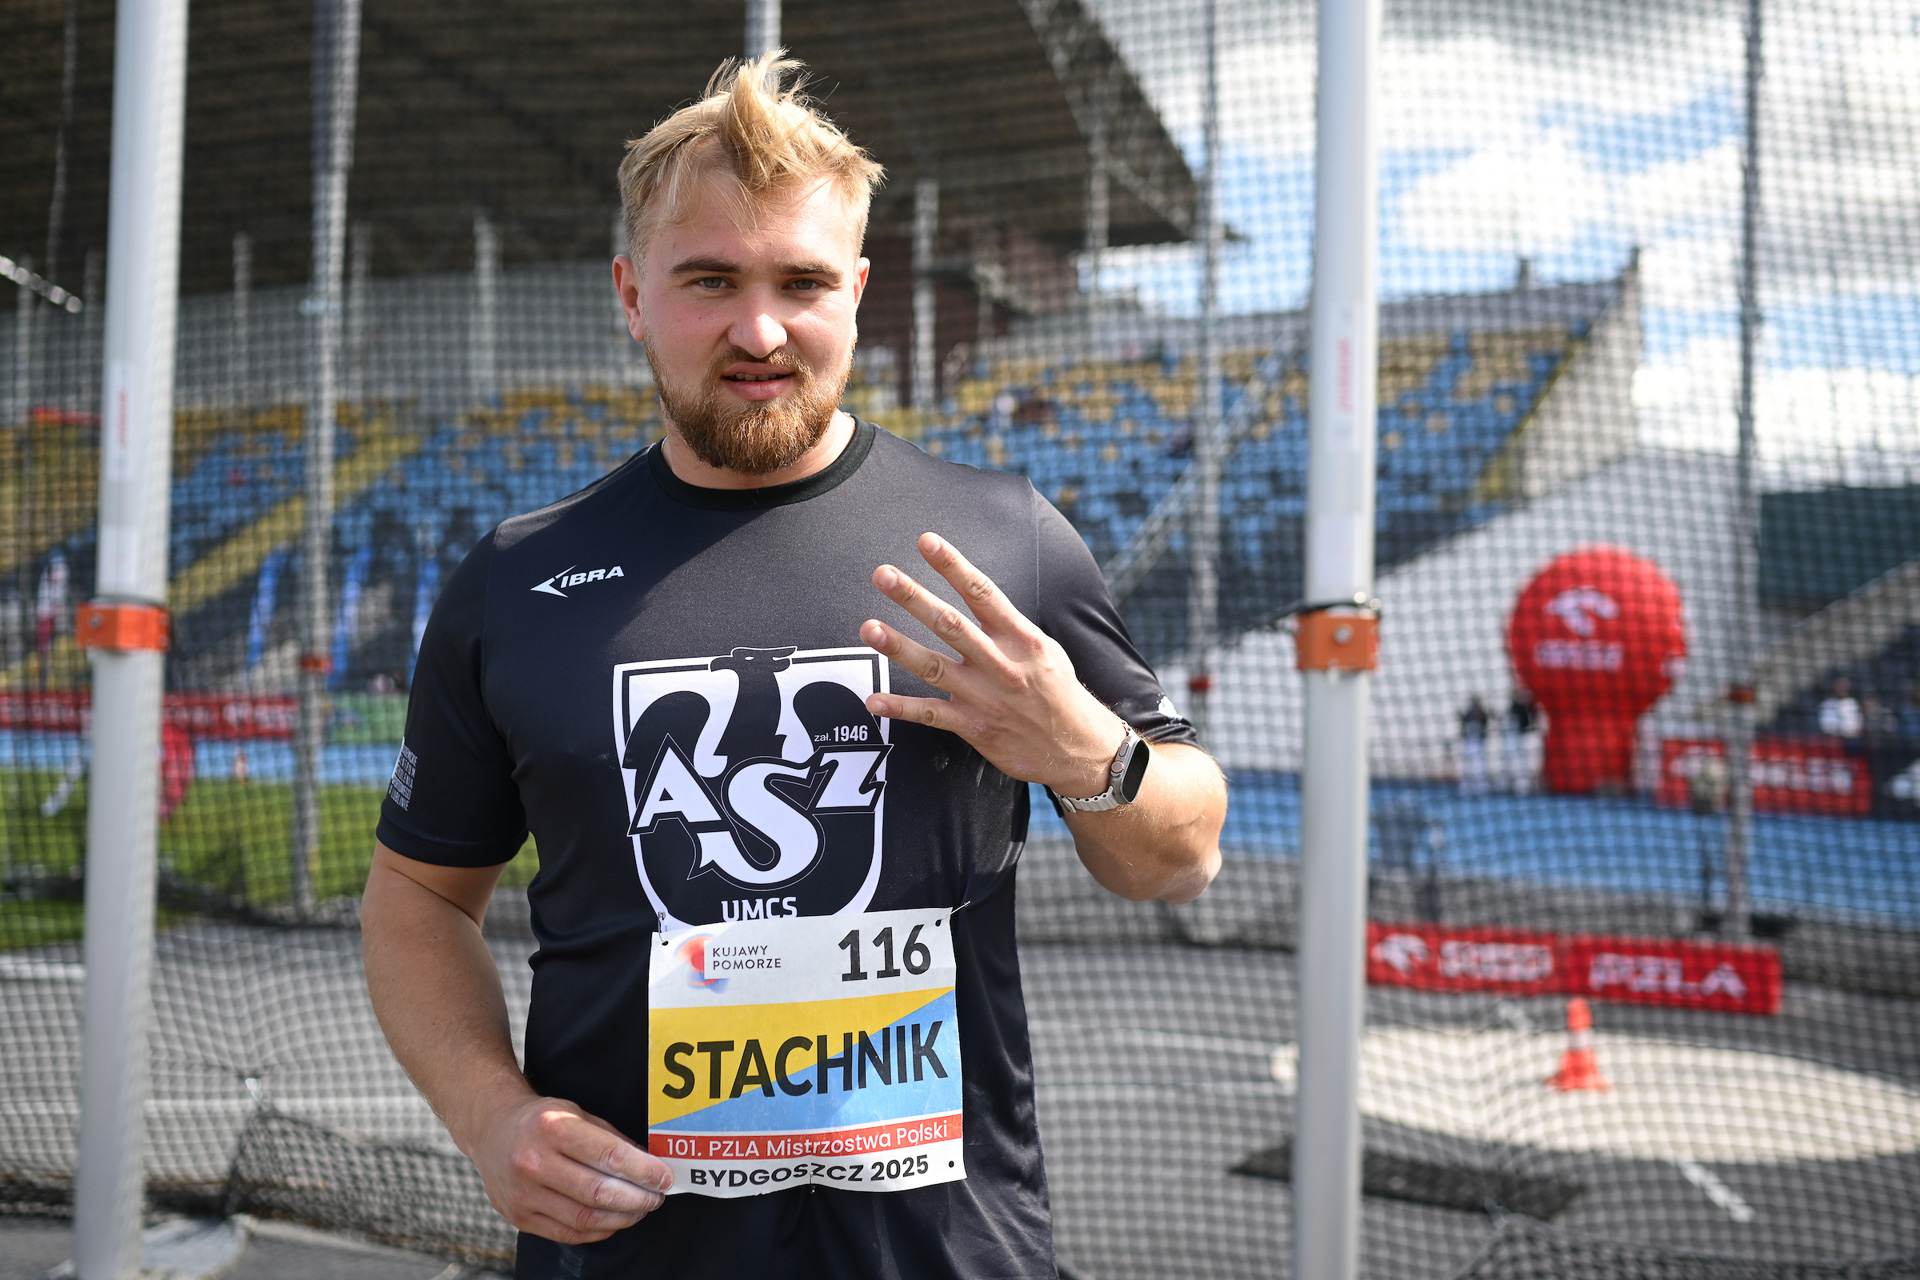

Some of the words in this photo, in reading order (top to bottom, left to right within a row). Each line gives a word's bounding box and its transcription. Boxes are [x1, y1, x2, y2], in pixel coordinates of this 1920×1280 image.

[814, 732, 832, 742] zał.
[833, 724, 868, 742] 1946
[721, 896, 798, 922] UMCS
[712, 945, 768, 957] KUJAWY
[712, 958, 782, 970] POMORZE
[838, 924, 932, 982] 116
[661, 1020, 949, 1100] STACHNIK
[667, 1138, 702, 1156] 101.
[709, 1139, 760, 1157] PZLA
[766, 1129, 892, 1157] Mistrzostwa
[896, 1120, 948, 1145] Polski
[690, 1162, 864, 1188] BYDGOSZCZ
[870, 1154, 929, 1182] 2025
